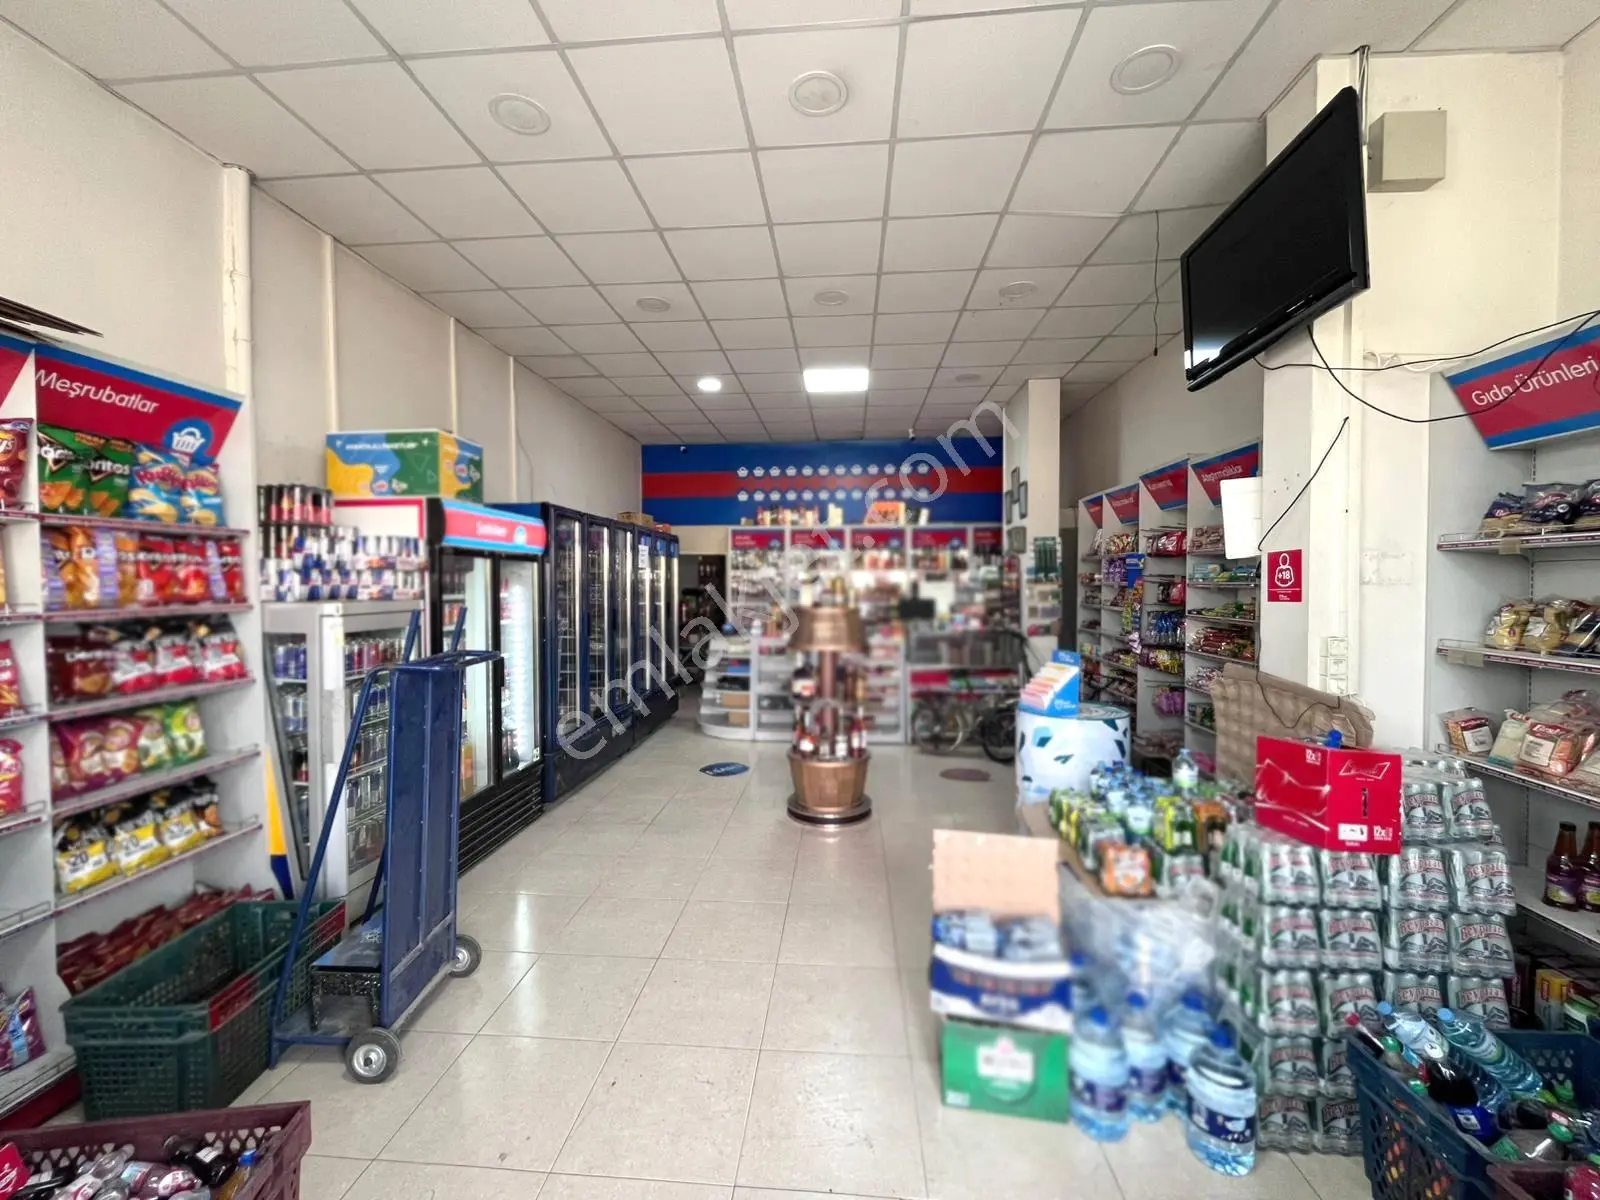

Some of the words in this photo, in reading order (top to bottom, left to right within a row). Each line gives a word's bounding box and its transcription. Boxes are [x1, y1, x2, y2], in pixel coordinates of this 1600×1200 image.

[35, 369, 160, 414] Meşrubatlar
[1471, 383, 1516, 406] Gıda
[1513, 355, 1599, 393] Ürünleri
[1277, 570, 1291, 579] +18
